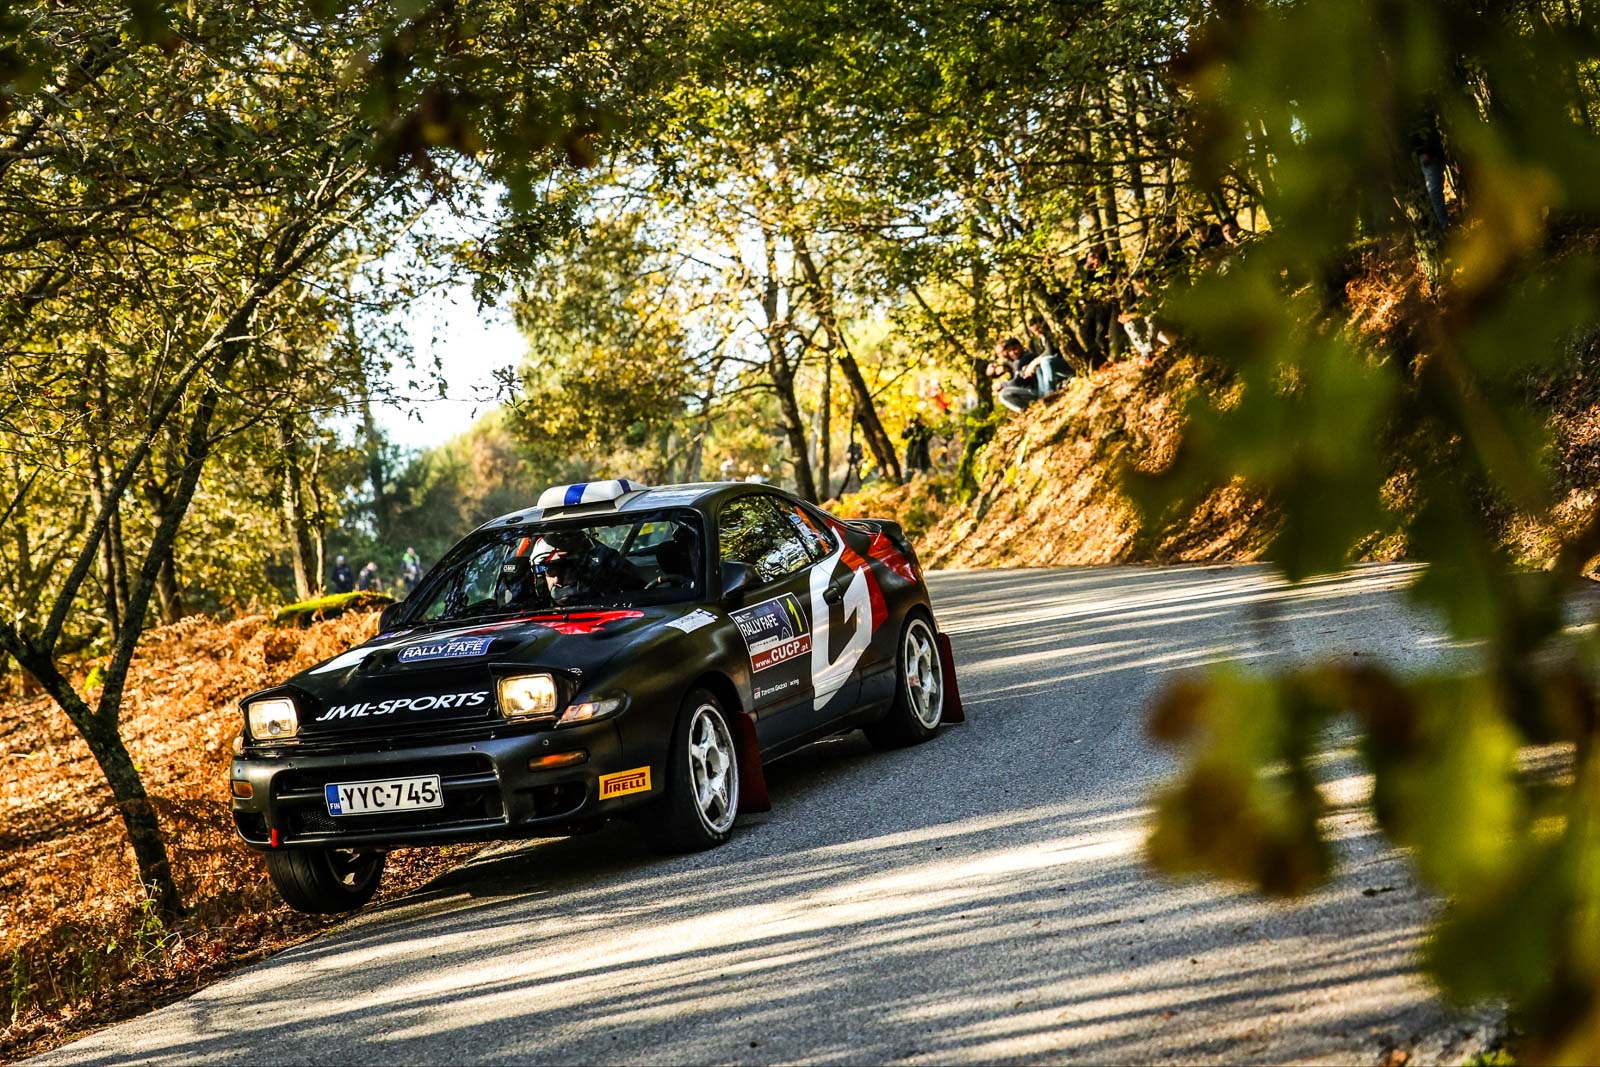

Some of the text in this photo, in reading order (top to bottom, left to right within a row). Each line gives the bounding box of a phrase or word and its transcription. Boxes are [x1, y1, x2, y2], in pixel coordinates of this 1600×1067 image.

[740, 618, 762, 637] RALLY
[760, 613, 779, 631] FAFE
[786, 598, 803, 632] 1
[402, 644, 448, 658] RALLY
[447, 643, 482, 653] FAFE
[755, 640, 809, 669] www.CUCP.pt
[315, 691, 490, 722] JML-SPORTS
[330, 781, 437, 810] FIN YYC-745
[603, 772, 646, 795] PIRELLI
